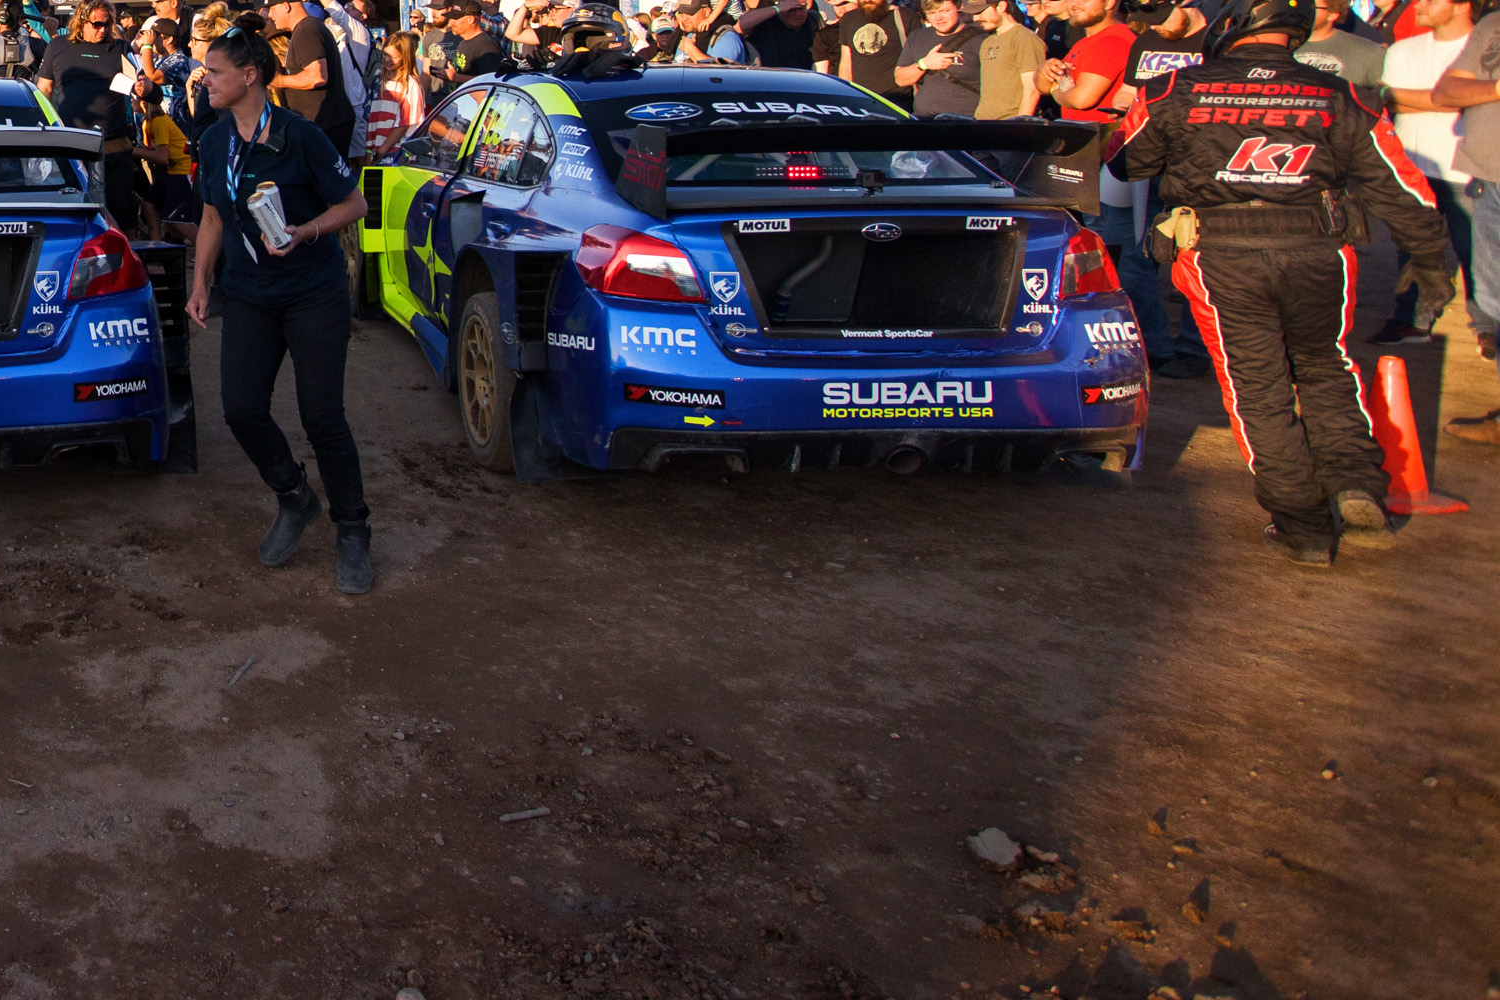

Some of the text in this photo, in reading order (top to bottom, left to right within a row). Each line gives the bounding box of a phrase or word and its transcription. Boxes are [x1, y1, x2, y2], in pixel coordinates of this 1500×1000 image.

[1137, 51, 1203, 73] KFAN
[1247, 68, 1276, 79] K1
[1192, 83, 1335, 98] RESPONSE
[711, 102, 869, 117] SUBARU
[1199, 96, 1328, 108] MOTORSPORTS
[1187, 108, 1338, 128] SAFETY
[565, 143, 587, 154] MOTUL
[1226, 137, 1316, 175] K1
[565, 161, 594, 180] KÜHL
[1058, 167, 1084, 178] SUBARU
[1215, 171, 1311, 184] RaceGear
[741, 220, 788, 231] MOTUL
[32, 303, 62, 315] KÜHL
[711, 304, 746, 316] KÜHL
[1023, 302, 1053, 313] KÜHL
[89, 317, 149, 340] KMC
[841, 329, 934, 339] Vermont SportsCar
[1084, 322, 1141, 343] KMC
[93, 338, 150, 347] WHEELS
[547, 332, 595, 351] SUBARU
[621, 326, 696, 348] KMC
[622, 346, 697, 355] WHEELS
[95, 379, 147, 397] YOKOHAMA
[823, 381, 993, 405] SUBARU
[1102, 382, 1141, 400] YOKOHAMA
[649, 389, 722, 406] YOKOHAMA
[823, 407, 994, 418] MOTORSPORTS USA
